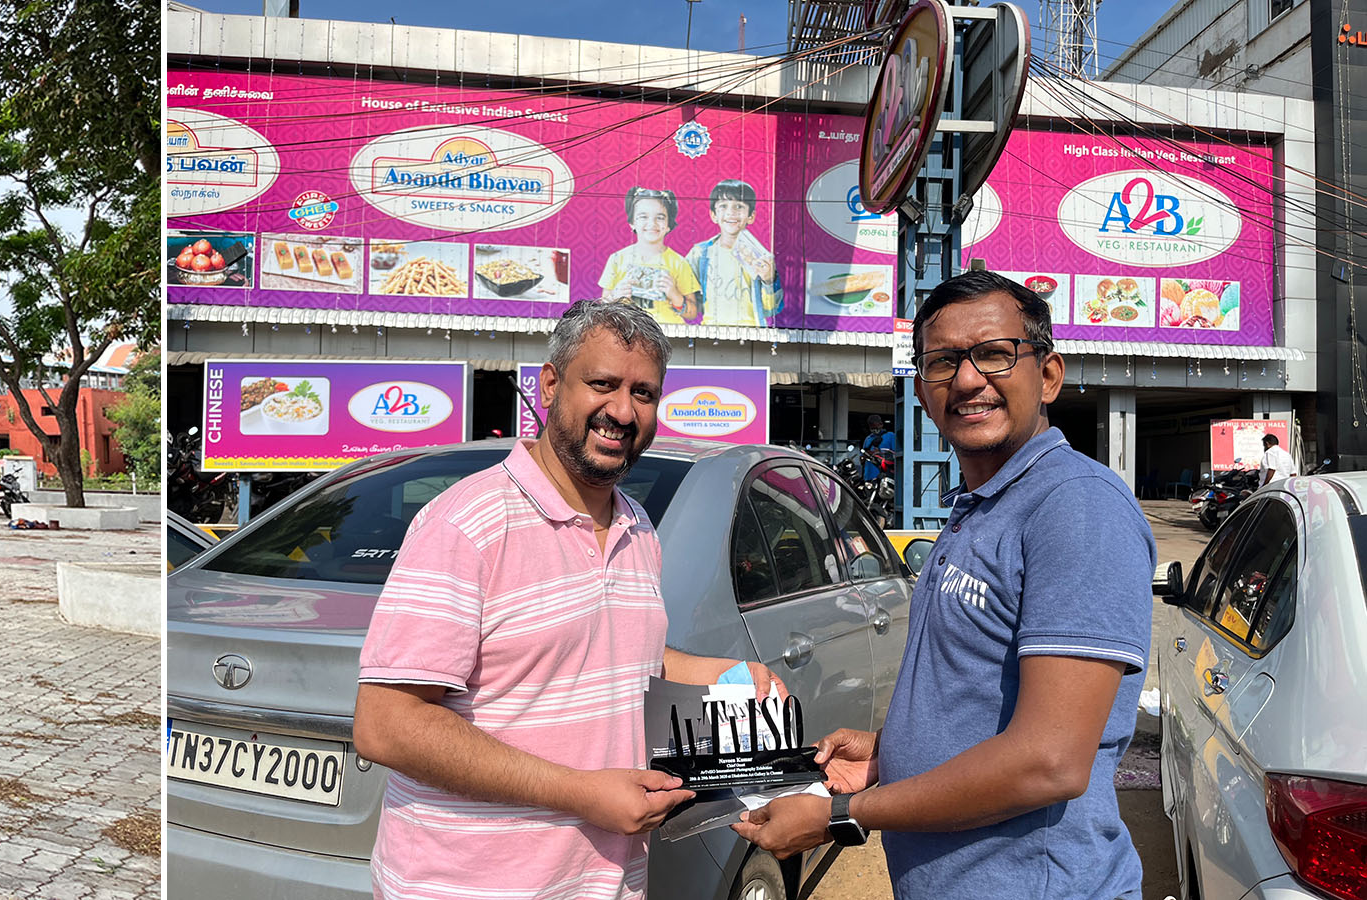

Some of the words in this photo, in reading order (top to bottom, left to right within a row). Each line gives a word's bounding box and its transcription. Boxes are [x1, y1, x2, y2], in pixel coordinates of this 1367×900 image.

[361, 97, 402, 110] House
[405, 99, 420, 111] of
[421, 101, 480, 116] Exclusive
[482, 106, 522, 118] Indian
[525, 108, 569, 123] Sweets
[442, 152, 487, 168] Adyar
[1064, 145, 1089, 157] High
[1091, 146, 1119, 158] Class
[1120, 147, 1154, 159] Indian
[1155, 150, 1178, 162] Veg.
[1180, 152, 1236, 165] Restaurant
[384, 167, 462, 189] Ananda
[468, 171, 542, 193] Bhavan
[295, 204, 333, 217] GHEE
[411, 200, 455, 212] SWEETS
[458, 203, 466, 212] &
[470, 203, 515, 215] SNACKS
[1099, 177, 1183, 236] A2B
[300, 213, 332, 229] SWEETS
[1097, 240, 1123, 250] VEG.
[1129, 242, 1203, 253] RESTAURANT
[208, 368, 224, 443] CHINESE
[371, 385, 420, 415] A2B
[697, 399, 717, 407] Adyar
[671, 408, 706, 417] Ananda
[708, 408, 742, 417] Bhavan
[351, 549, 391, 558] SRT
[170, 731, 339, 793] TN37CY2000
